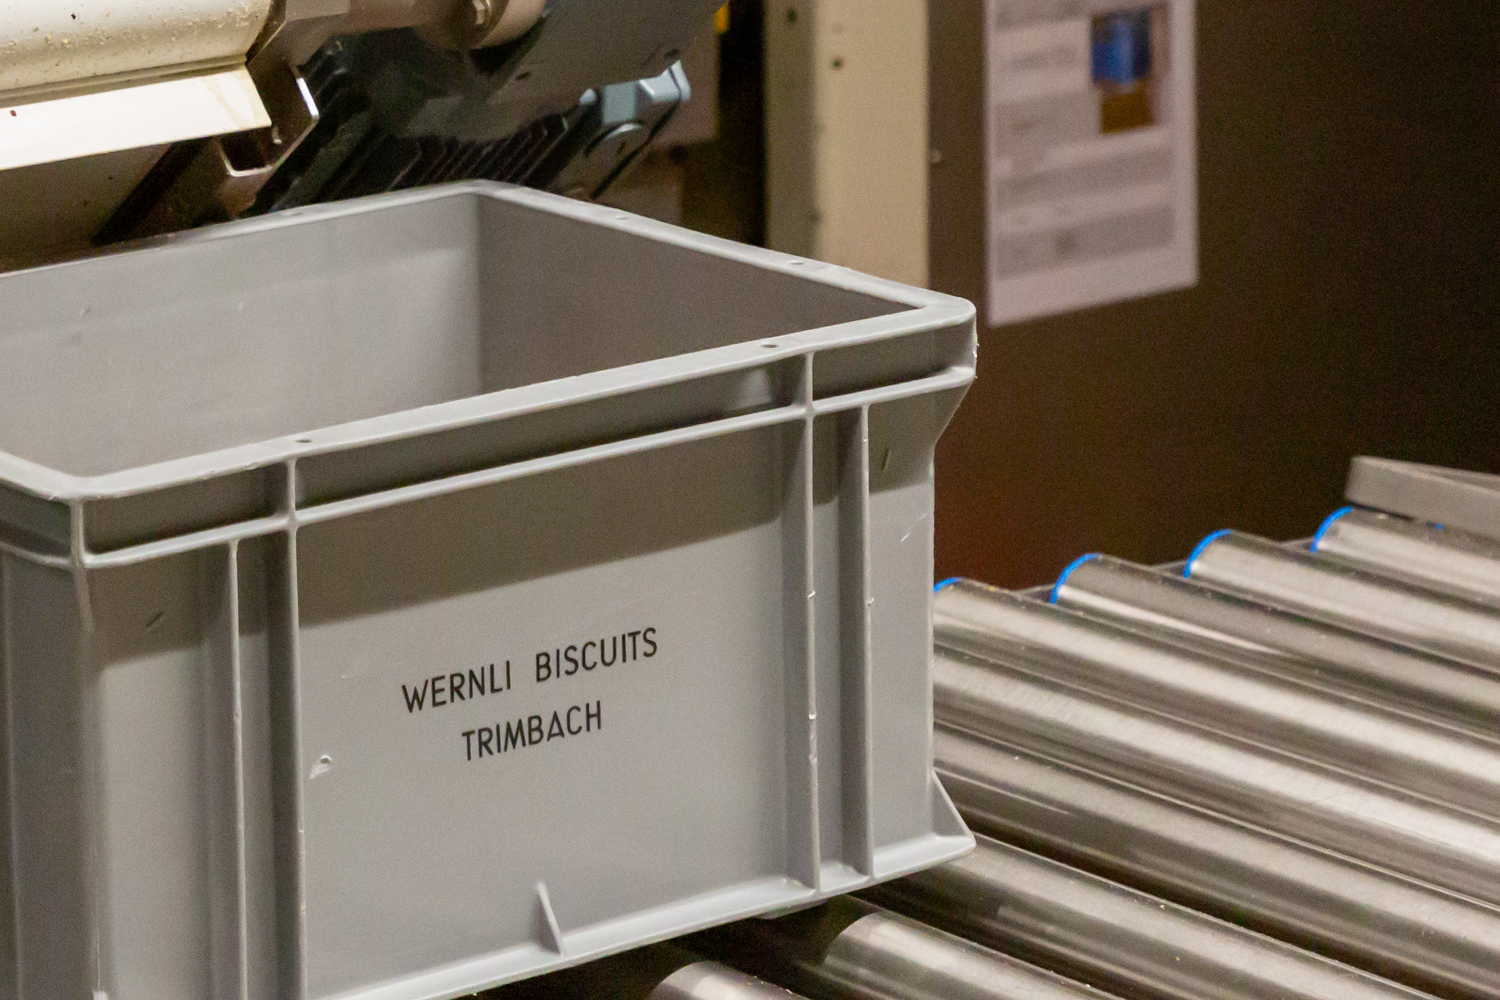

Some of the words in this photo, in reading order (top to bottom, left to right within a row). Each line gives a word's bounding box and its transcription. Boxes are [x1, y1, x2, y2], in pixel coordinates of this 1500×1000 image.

[402, 660, 512, 713] WERNLI
[536, 627, 658, 684] BISCUITS
[461, 700, 602, 761] TRIMBACH
